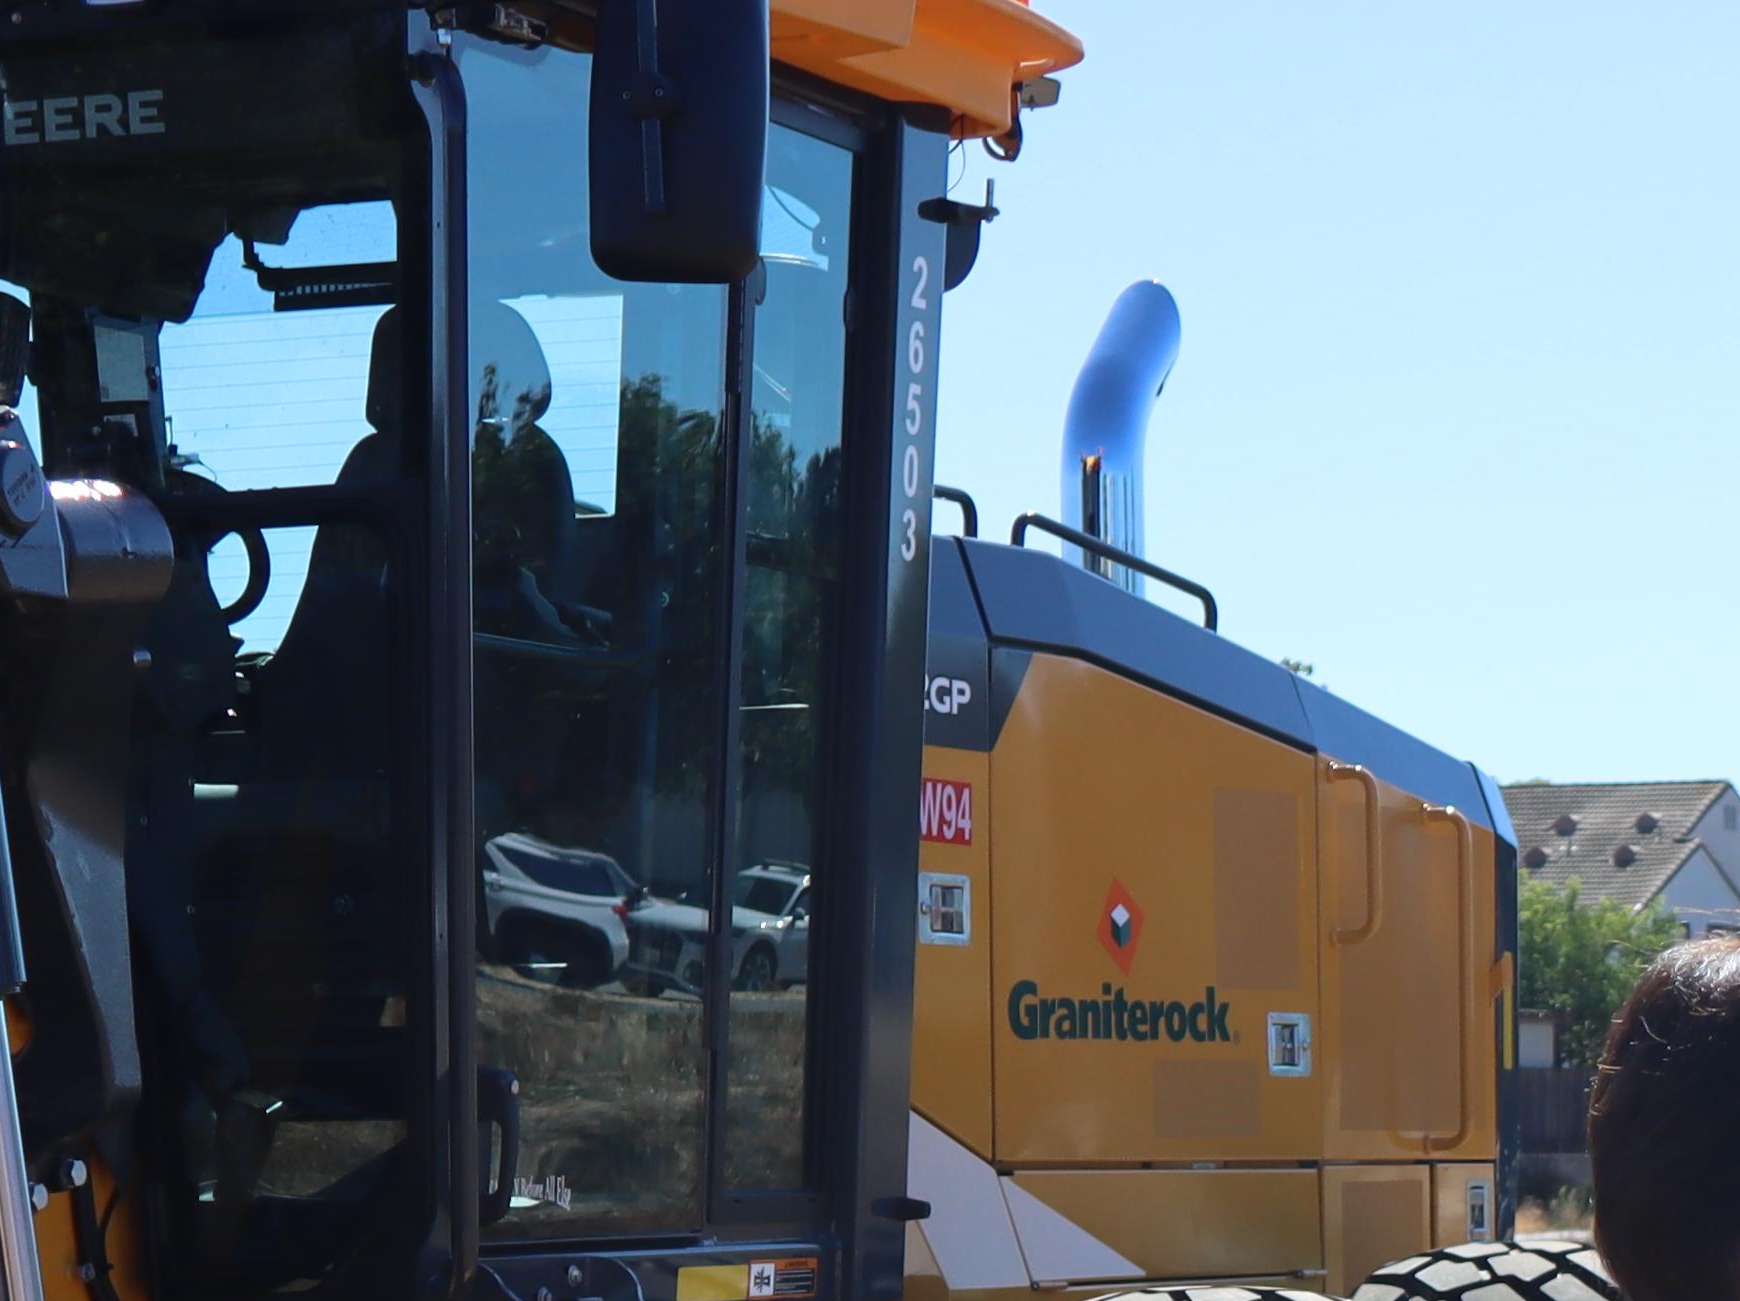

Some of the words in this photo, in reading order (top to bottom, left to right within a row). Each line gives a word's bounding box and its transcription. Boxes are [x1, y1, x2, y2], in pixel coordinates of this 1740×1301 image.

[900, 256, 929, 561] 26503
[1007, 979, 1232, 1043] Graniterock
[556, 1175, 572, 1212] Else
